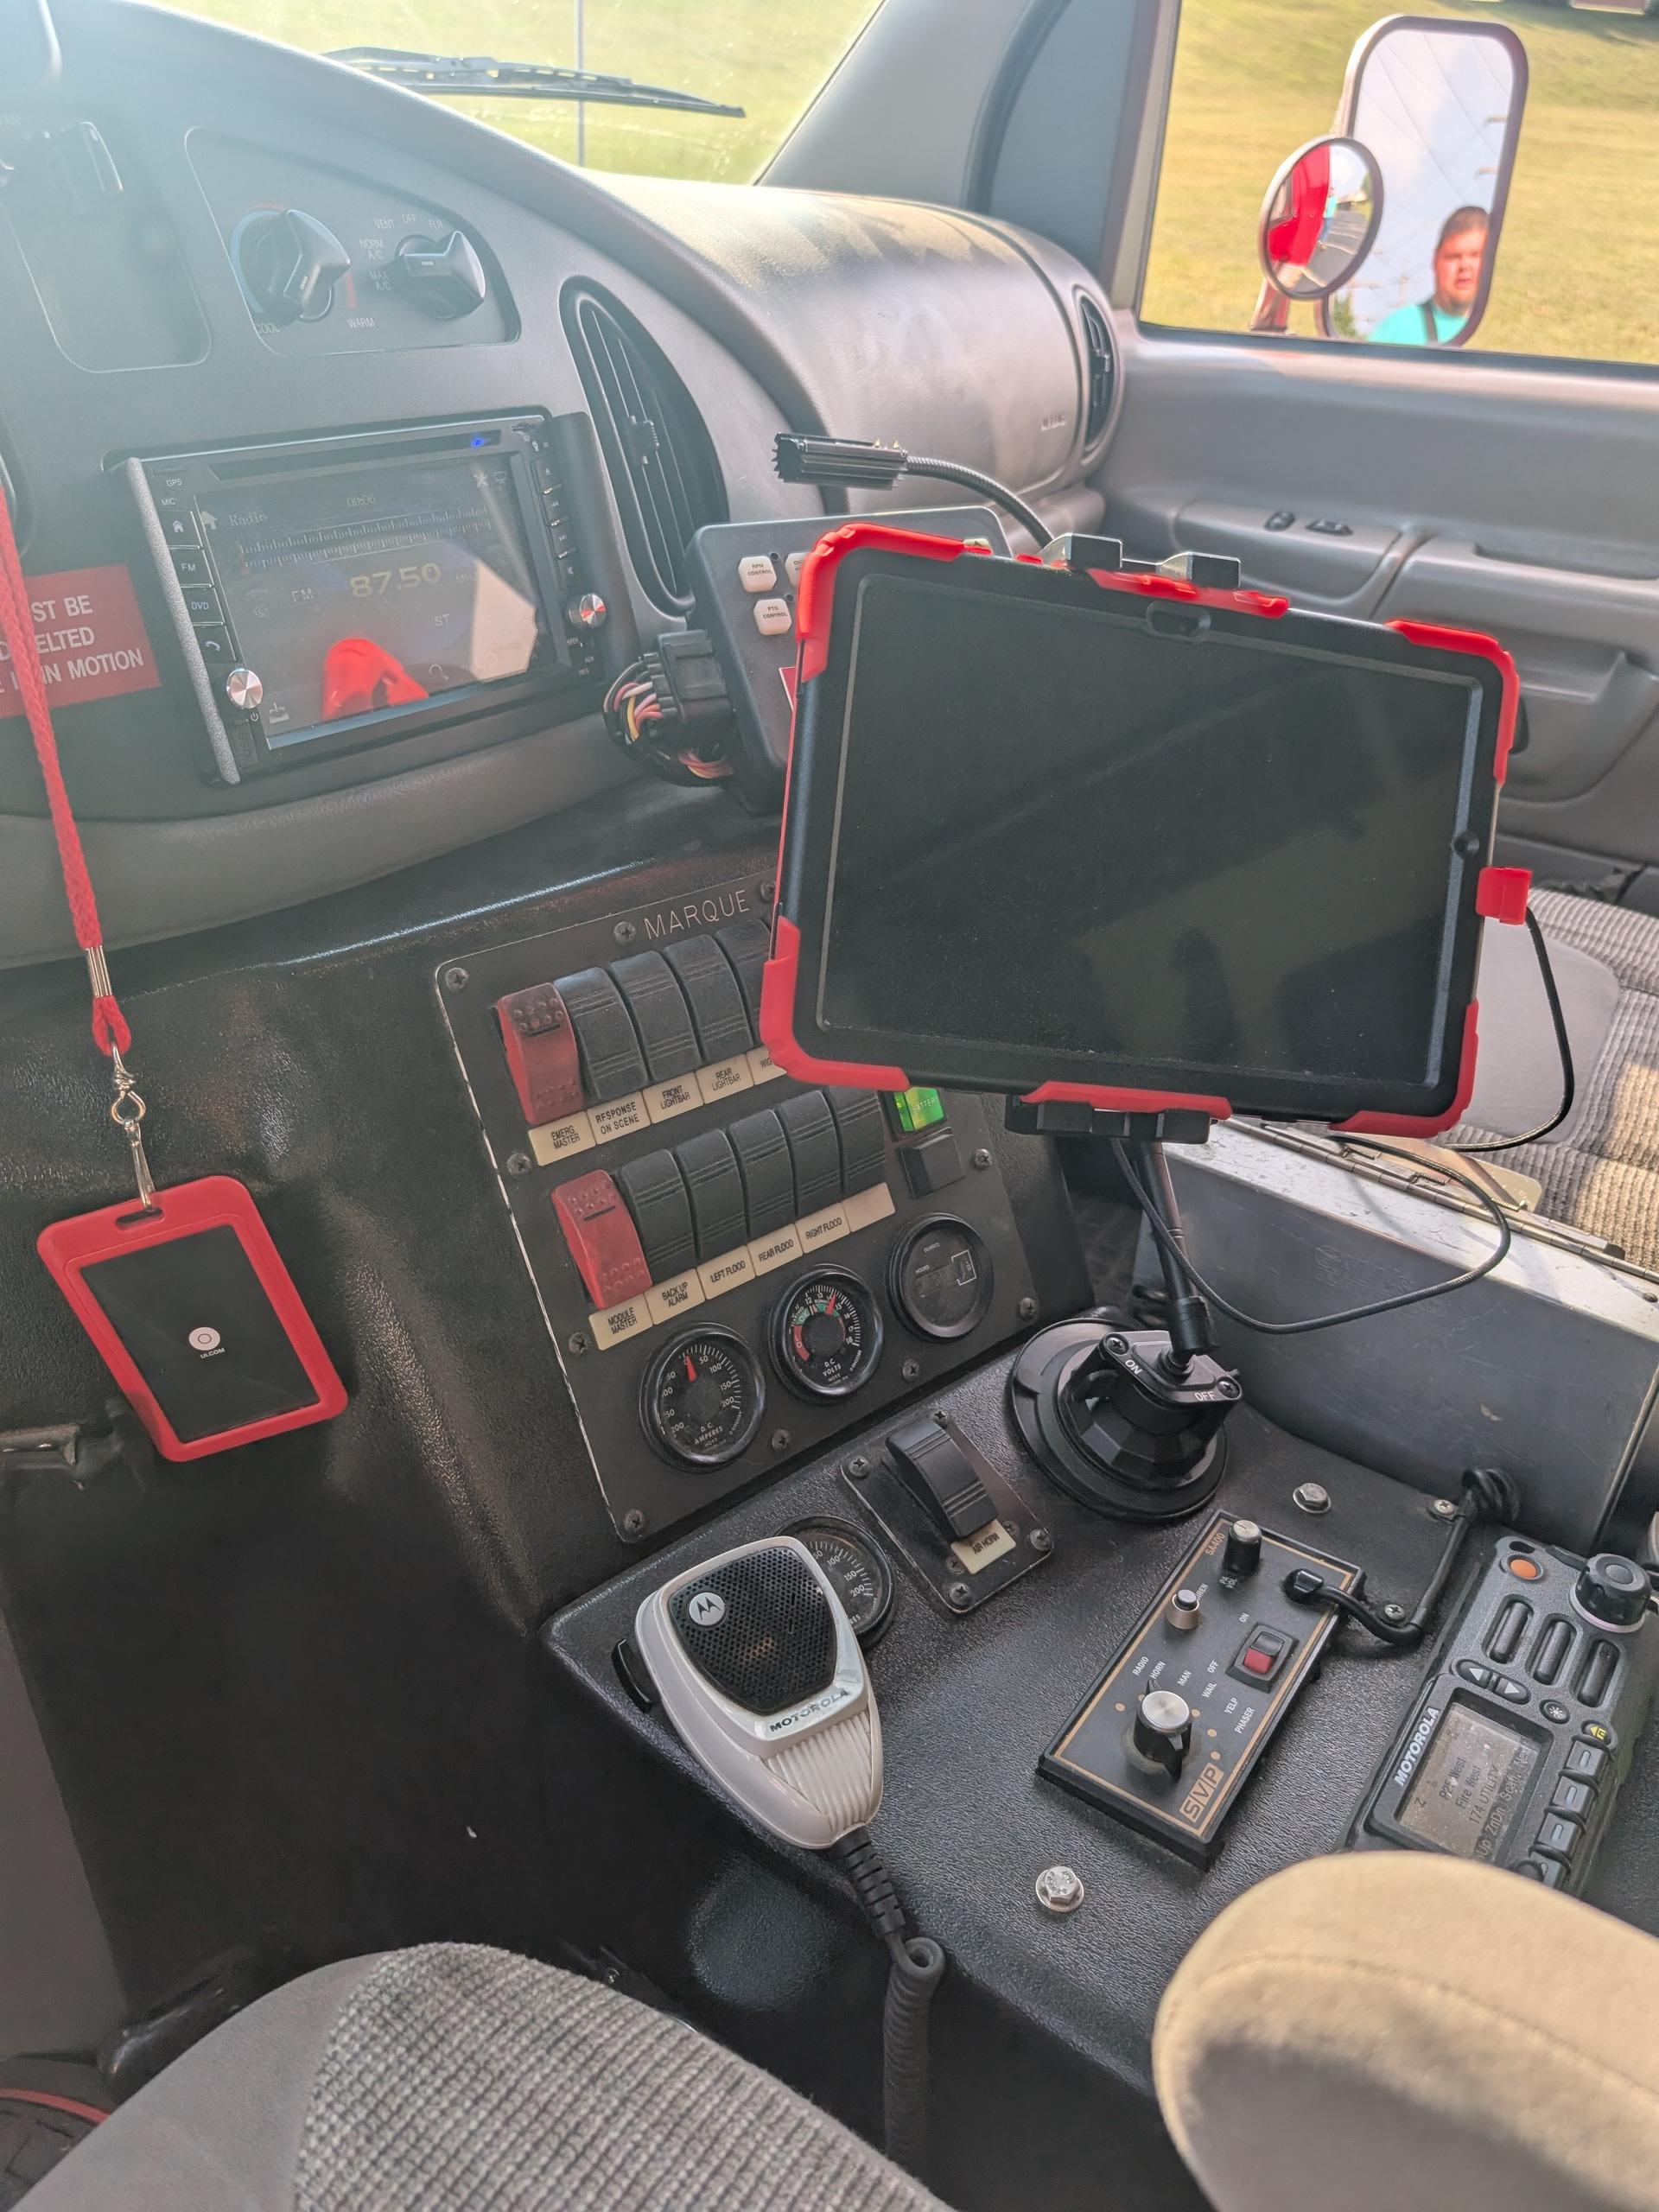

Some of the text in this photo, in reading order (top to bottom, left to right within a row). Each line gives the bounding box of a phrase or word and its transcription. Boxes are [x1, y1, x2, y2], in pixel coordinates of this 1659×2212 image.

[374, 219, 395, 230] VENT
[402, 213, 417, 224] OFF
[359, 238, 385, 249] NORM
[367, 249, 384, 260] A/C
[370, 270, 388, 281] MAX
[376, 281, 392, 291] A/C
[253, 322, 281, 334] COOL
[346, 317, 376, 329] WARM
[166, 478, 182, 487] GPS
[162, 498, 176, 506] MIC
[228, 512, 268, 527] Radio
[181, 563, 196, 573] FM
[349, 563, 442, 599] 87.50
[31, 594, 94, 622] ST BE
[191, 601, 209, 611] DVD
[435, 613, 450, 627] ST
[35, 626, 96, 655] ELTED
[67, 648, 144, 680] MOTION
[644, 889, 750, 941] MARQUE
[715, 1067, 733, 1081] REAR
[712, 1074, 741, 1091] LIGHTBAR
[662, 1084, 683, 1100] FRONT
[660, 1091, 691, 1110] LIGHTBAR
[595, 1101, 638, 1124] RESPONSE
[600, 1113, 640, 1135] ON SCENE
[550, 1125, 575, 1141] EMERG
[553, 1134, 581, 1150] MASTER
[805, 1217, 843, 1240] RIGHT FLOOD
[759, 1239, 795, 1262] REAR FLOOD
[710, 1260, 746, 1284] LEFT FLOOD
[662, 1281, 689, 1301] BACK UP
[668, 1293, 689, 1308] ALARM
[835, 1302, 843, 1311] 15
[607, 1306, 635, 1325] MODULE
[611, 1316, 638, 1335] MASTER
[699, 1355, 709, 1365] 50
[1125, 1359, 1143, 1375] ON
[709, 1363, 722, 1374] 100
[823, 1363, 842, 1376] VOLTS
[719, 1380, 732, 1391] 150
[720, 1396, 735, 1408] 200
[1194, 1391, 1217, 1402] OFF
[694, 1425, 724, 1446] AMPERES
[971, 1532, 1001, 1554] AIR HORN
[1205, 1532, 1226, 1556] SA400
[812, 1550, 823, 1560] 50
[827, 1555, 841, 1567] 100
[843, 1570, 857, 1581] 150
[1219, 1575, 1230, 1586] PA
[850, 1584, 865, 1597] 200
[1224, 1577, 1238, 1591] VOL
[1239, 1612, 1250, 1624] ON
[1132, 1656, 1149, 1676] RADIO
[1149, 1660, 1166, 1680] HORN
[1207, 1659, 1219, 1674] OFF
[1177, 1669, 1192, 1687] MAN
[1202, 1681, 1217, 1699] WAIL
[769, 1688, 851, 1733] MOTOROLA
[1224, 1697, 1239, 1715] YELP
[1234, 1707, 1256, 1734] PHASER
[1393, 1707, 1440, 1788] MOTOROLA
[1446, 1757, 1467, 1780] West
[1180, 1764, 1223, 1821] SVP
[1455, 1765, 1483, 1810] Fire West
[1469, 1764, 1499, 1825] 174 UTILITY
